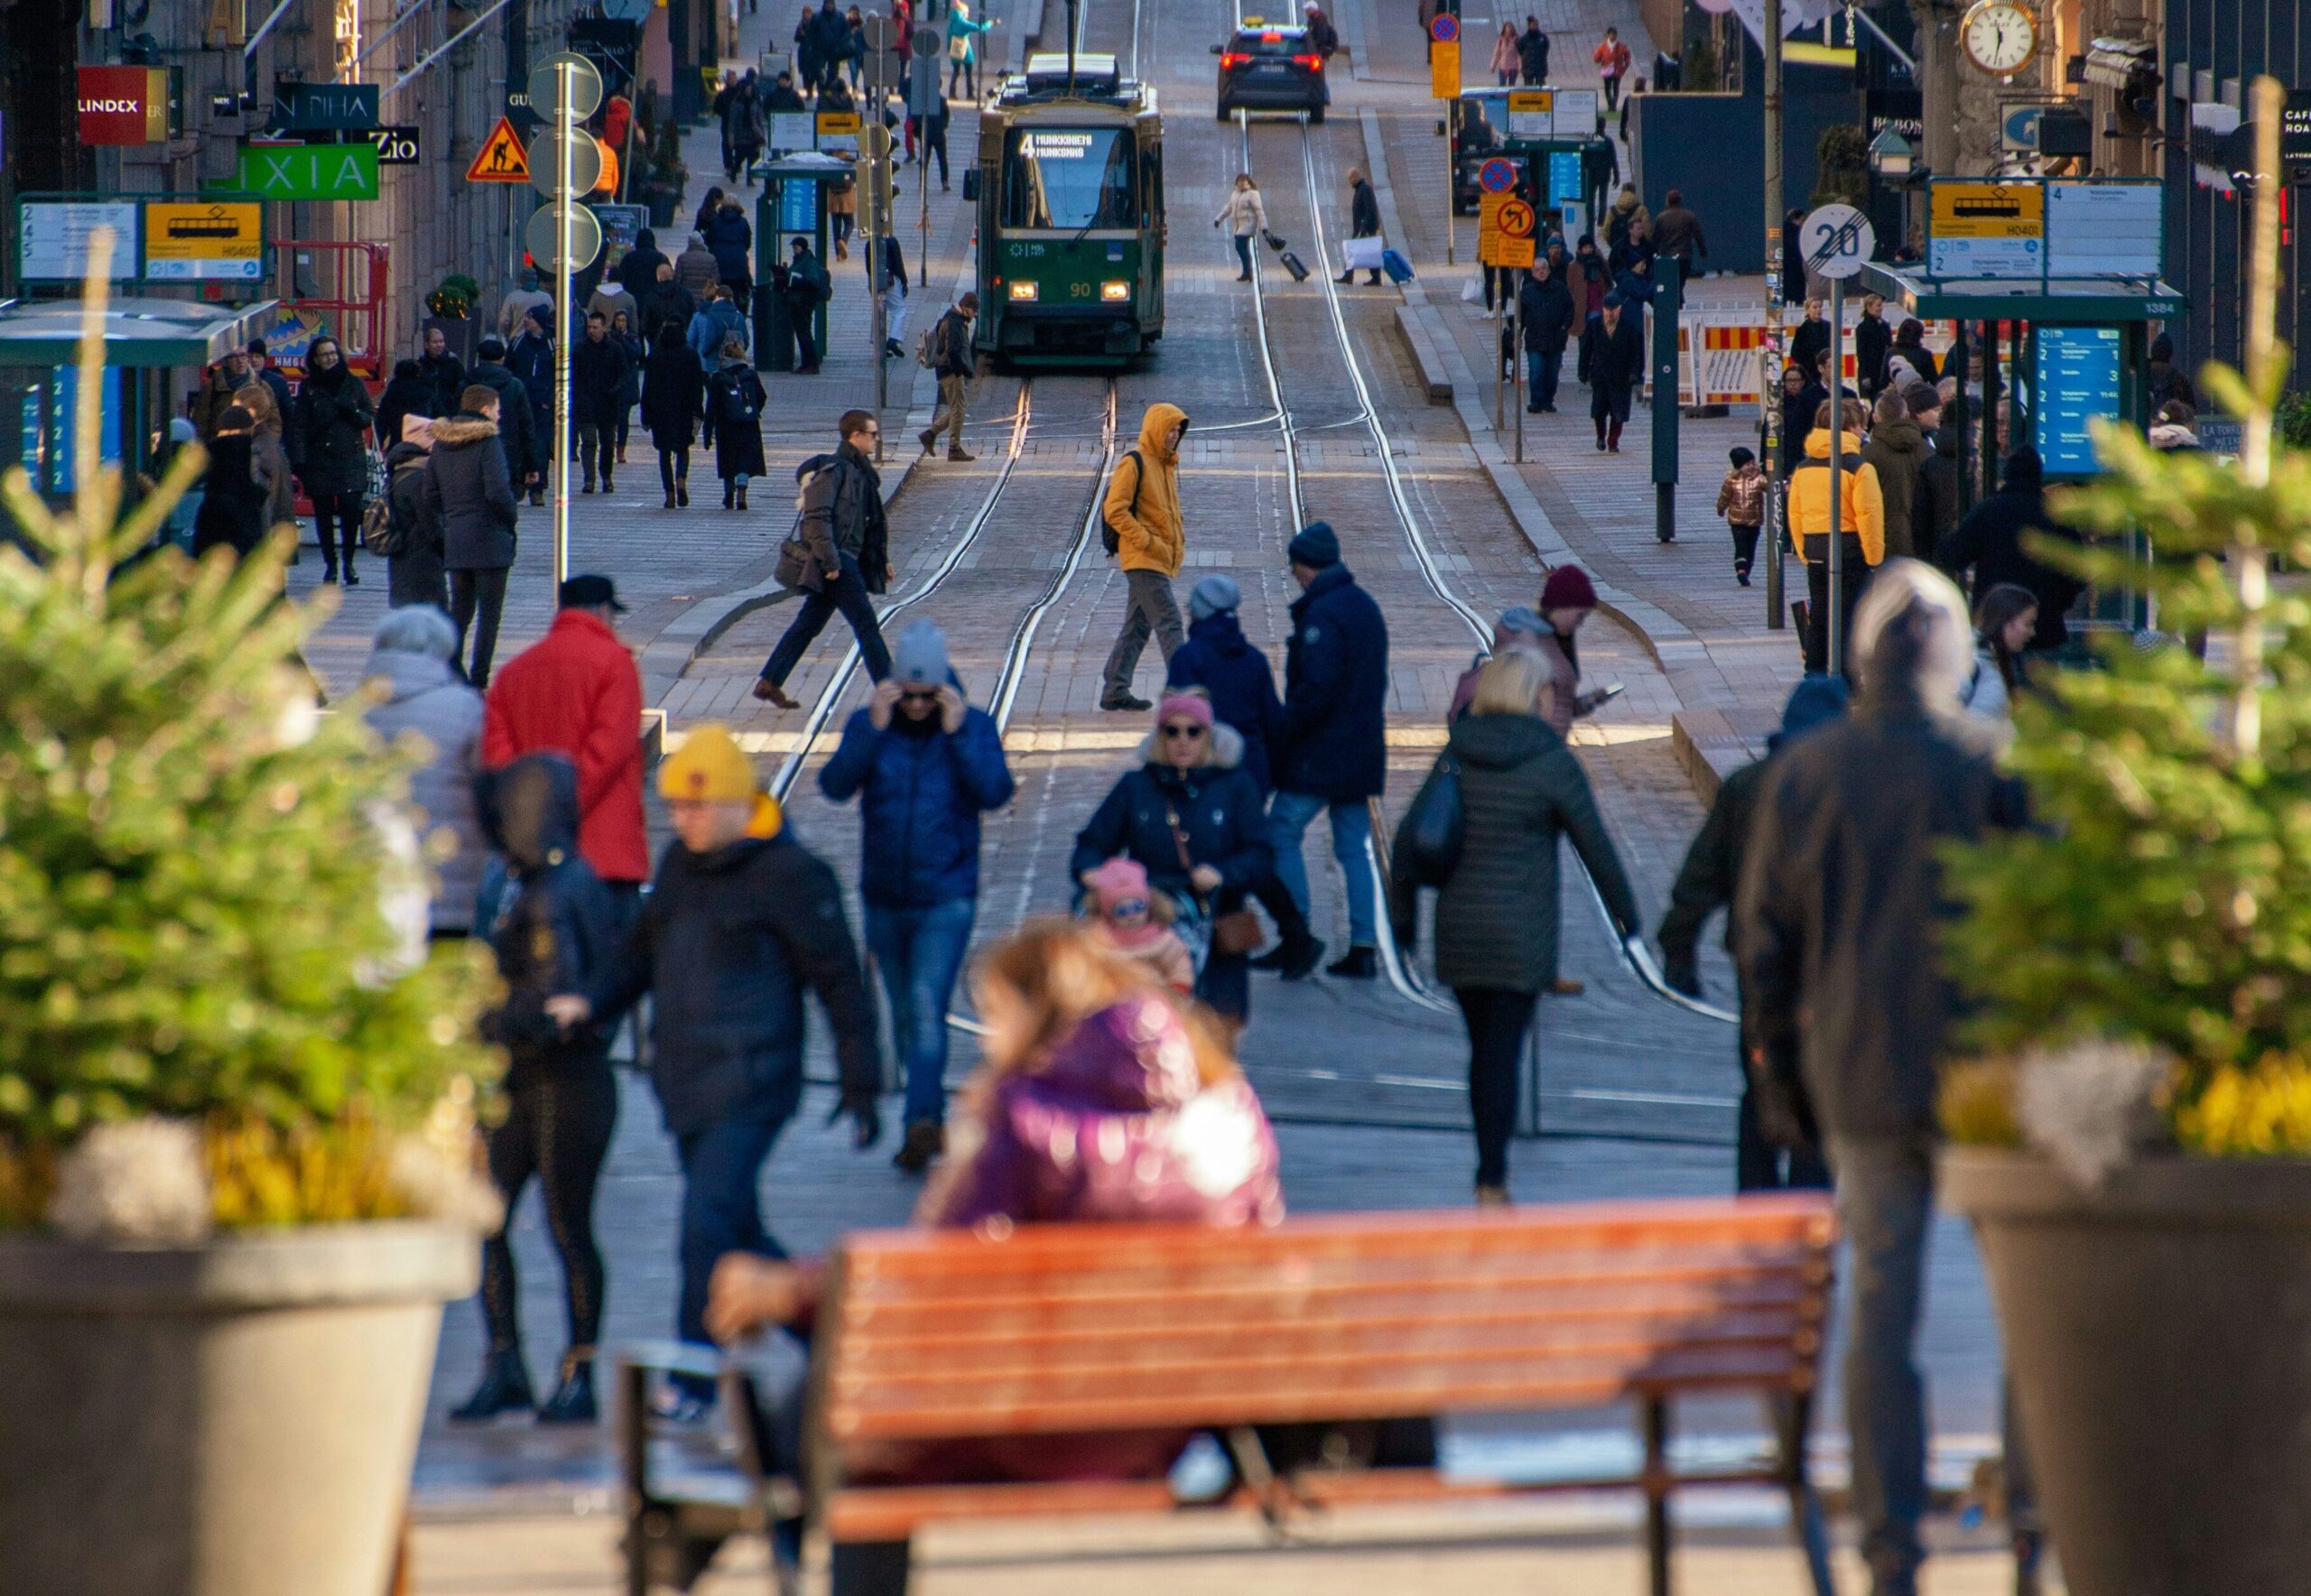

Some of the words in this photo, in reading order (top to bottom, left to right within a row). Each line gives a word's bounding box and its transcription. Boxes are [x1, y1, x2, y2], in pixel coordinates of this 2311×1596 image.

[78, 99, 137, 112] LINDEX
[509, 94, 533, 106] GU
[368, 132, 417, 159] Zio
[1020, 134, 1035, 158] 4
[1036, 135, 1091, 145] MUNKKINIEMI
[2054, 187, 2063, 200] 4
[23, 206, 32, 221] 2
[1816, 223, 1860, 259] 20
[1935, 257, 1944, 271] 2
[1071, 283, 1091, 297] 90
[2039, 349, 2046, 360] 2
[2109, 370, 2118, 382] 3
[2039, 391, 2046, 402] 2
[2039, 432, 2046, 444] 2
